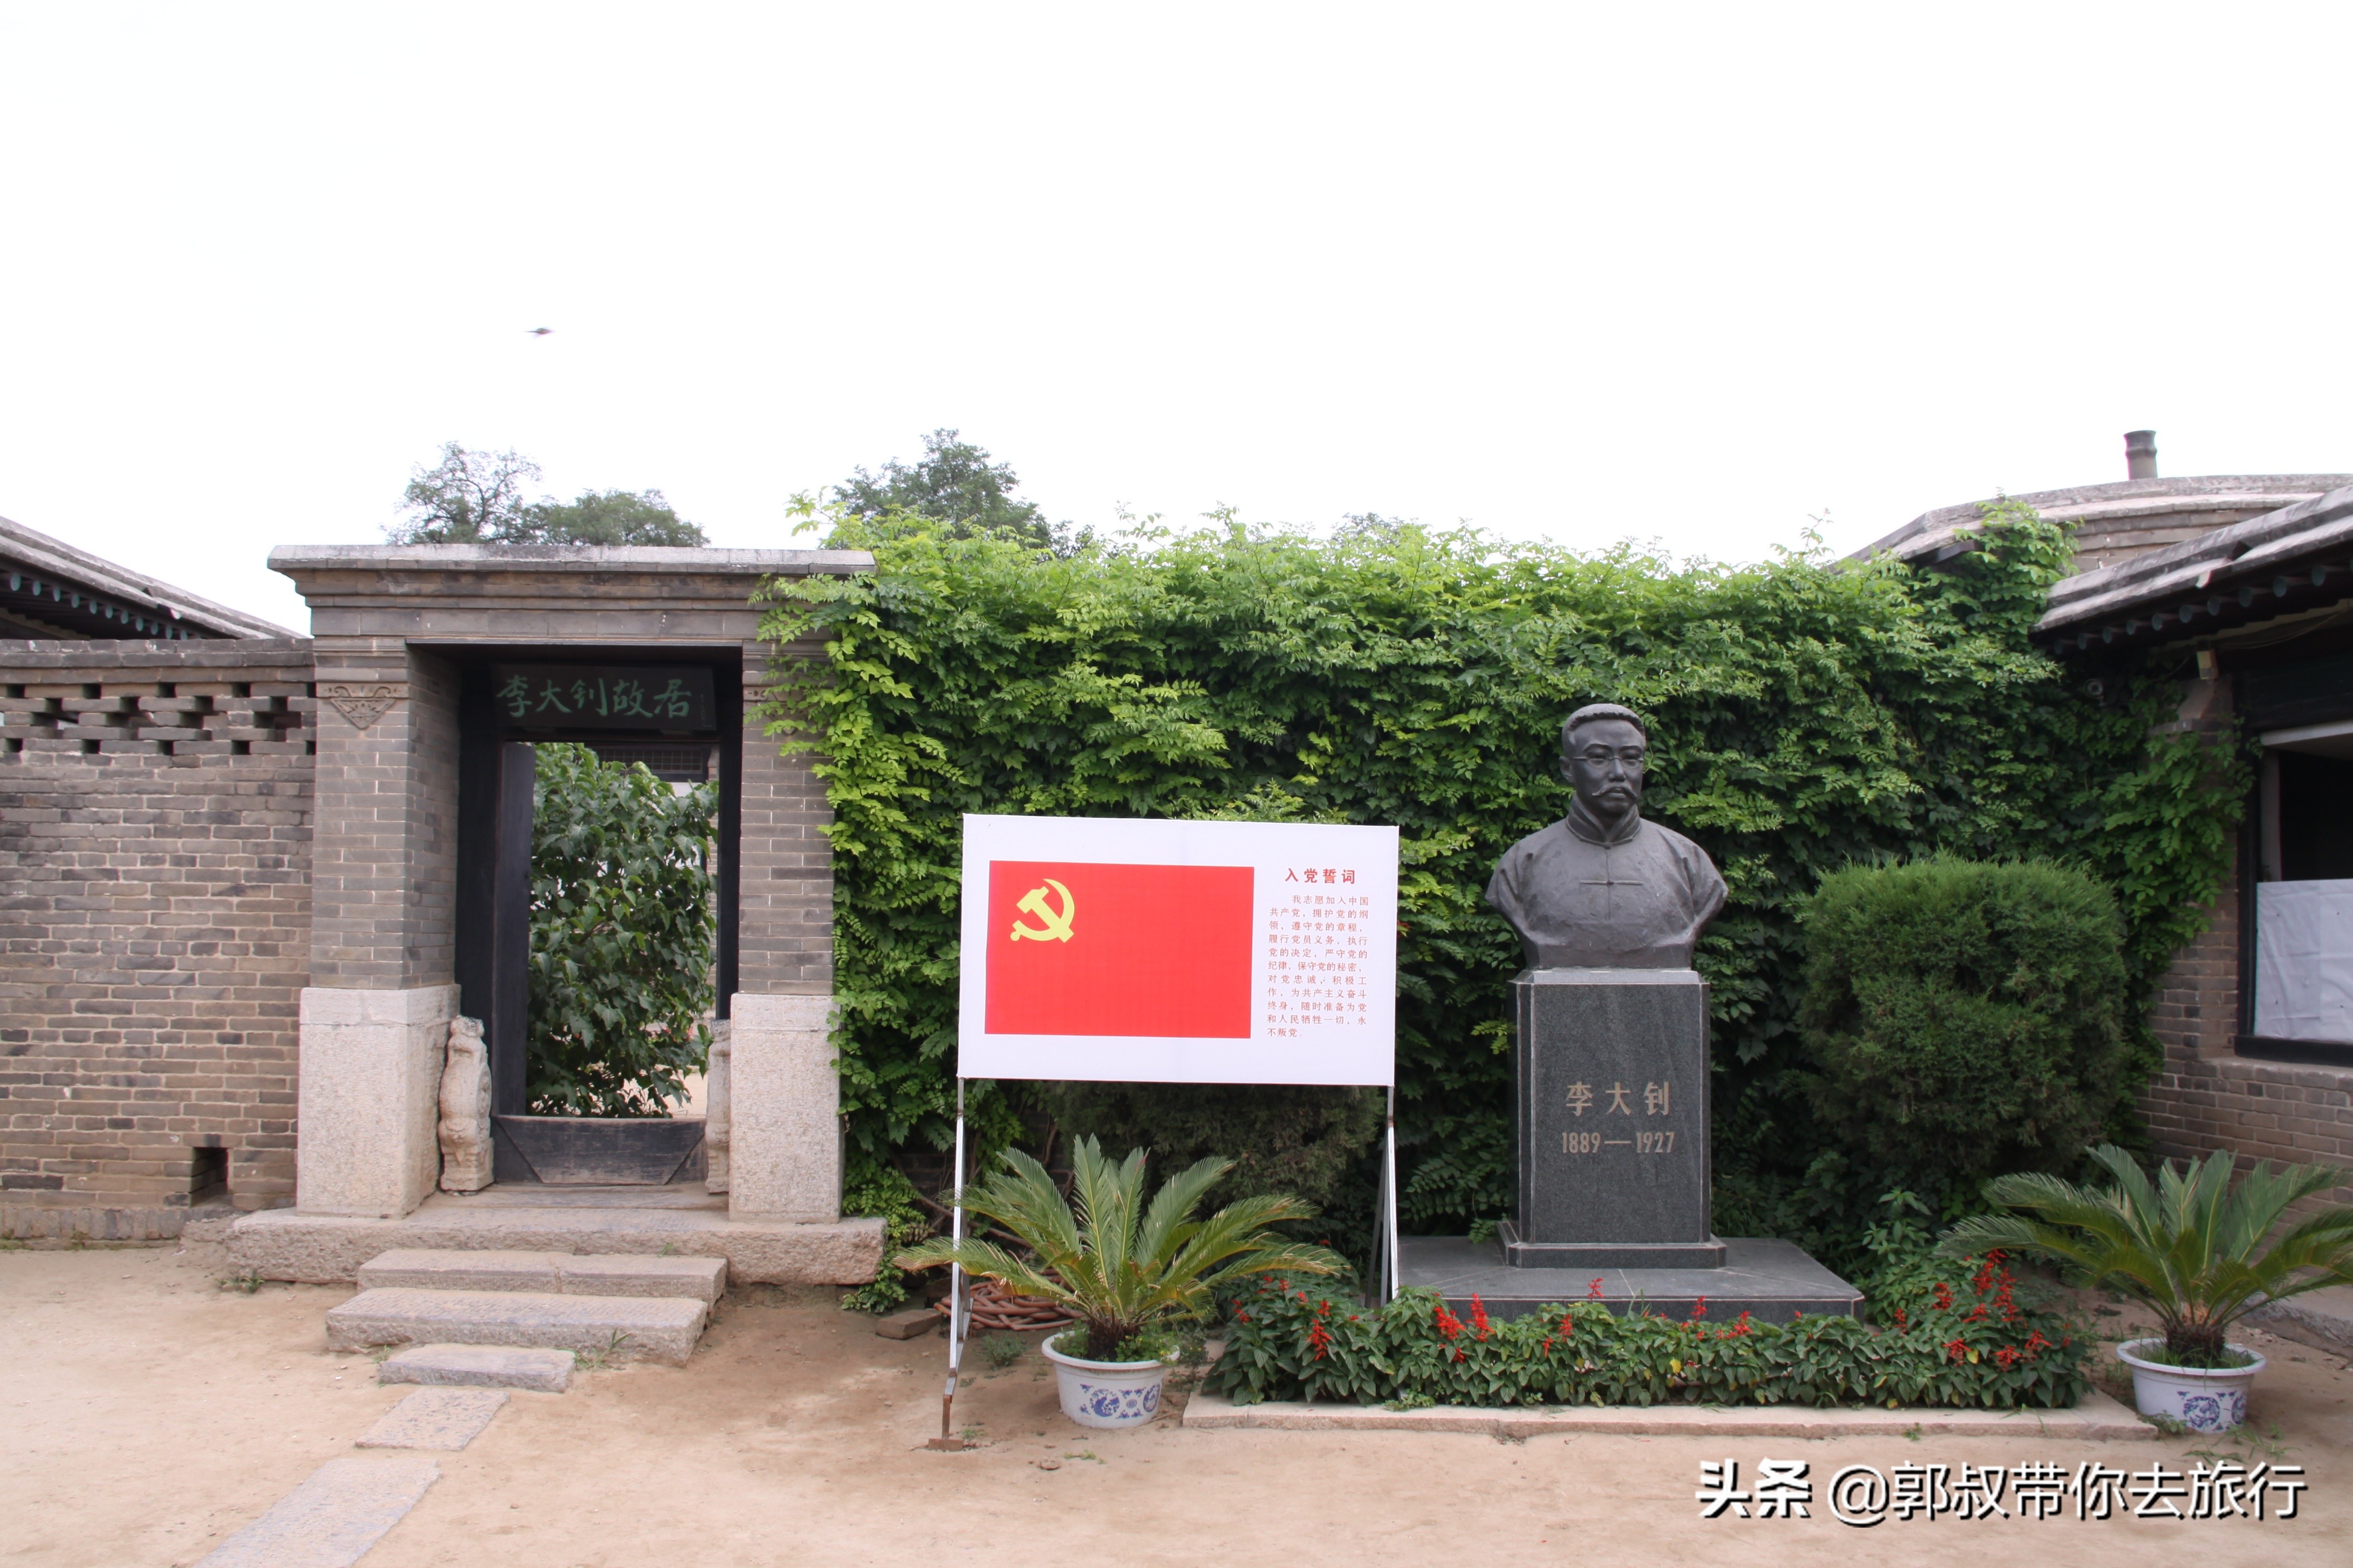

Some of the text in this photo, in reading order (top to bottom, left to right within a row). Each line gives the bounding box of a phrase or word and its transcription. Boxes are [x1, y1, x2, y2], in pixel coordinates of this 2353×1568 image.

[496, 674, 692, 719] 李大钊故居
[1285, 868, 1355, 884] 入党誓词
[1292, 895, 1368, 906] 我志愿加入中国
[1269, 908, 1368, 919] 共产党，拥护党的纲
[1269, 921, 1363, 933] 领，遵守党的章程，
[1268, 934, 1368, 946] 履行党员义务，执行
[1268, 948, 1368, 959] 党的决定，严守党的
[1268, 961, 1363, 972] 纪律，保守党的秘密，
[1268, 975, 1367, 985] 对党忠诚，积极工
[1267, 988, 1367, 999] 作，为共产主义奋斗
[1267, 1001, 1367, 1012] 终身，随时准备为党
[1267, 1014, 1367, 1025] 和人民牺牲一切，永
[1267, 1028, 1303, 1037] 不叛党。
[1566, 1081, 1670, 1117] 李大钊
